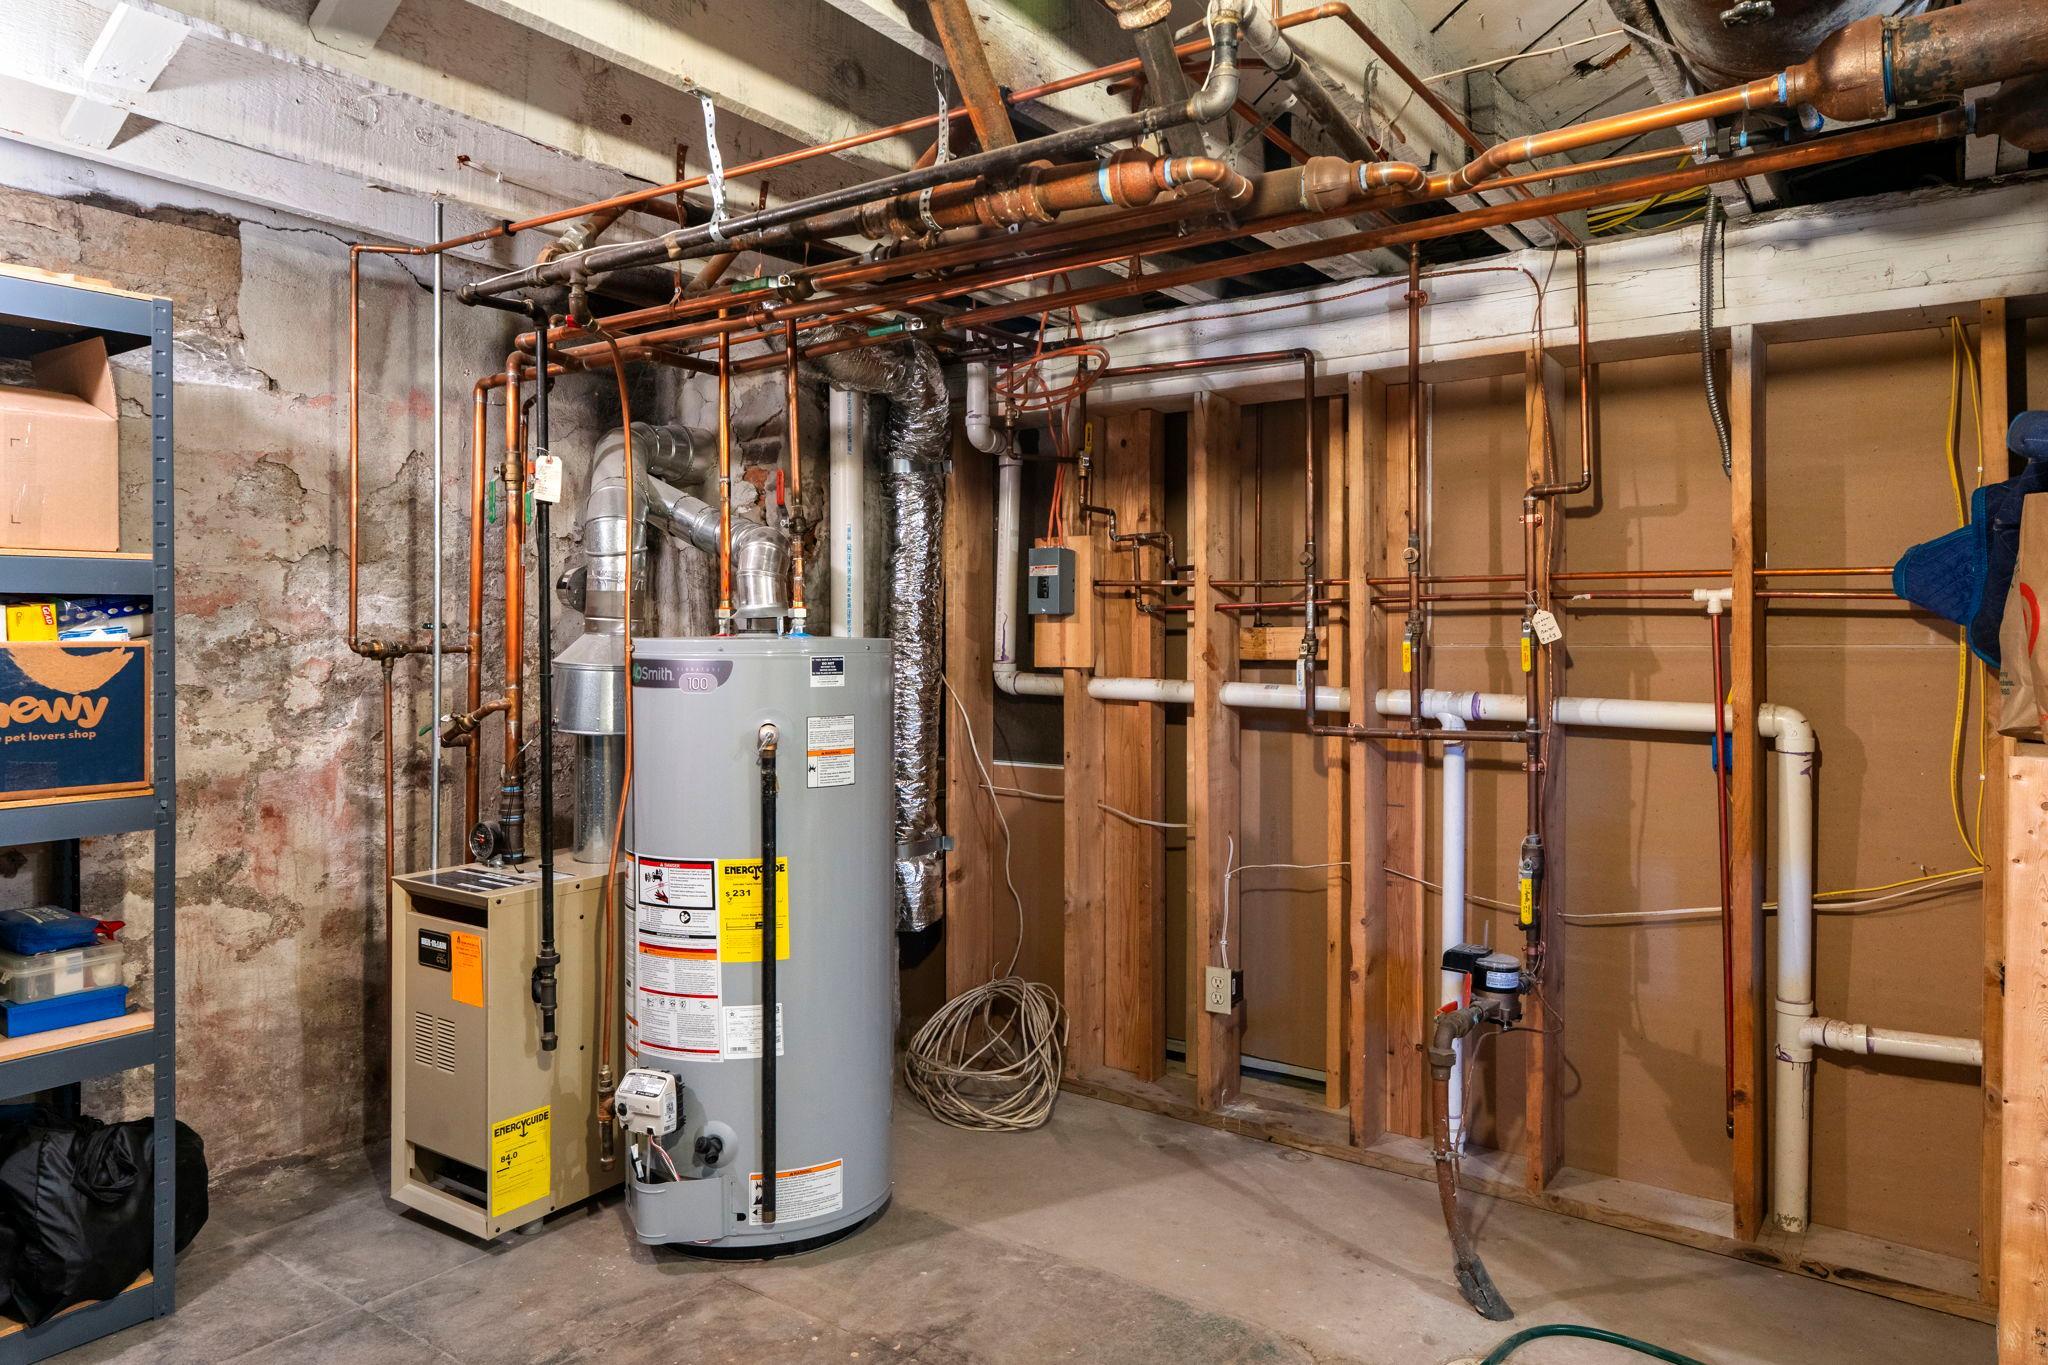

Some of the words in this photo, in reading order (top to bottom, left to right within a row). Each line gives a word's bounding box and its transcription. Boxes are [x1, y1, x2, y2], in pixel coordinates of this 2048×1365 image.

[42, 606, 53, 625] GLAD
[687, 677, 708, 690] 100
[4, 733, 27, 745] pet
[28, 731, 66, 741] lovers
[68, 729, 97, 740] shop
[494, 1111, 550, 1138] ENERGYGUIDE
[500, 1151, 518, 1164] 84.0
